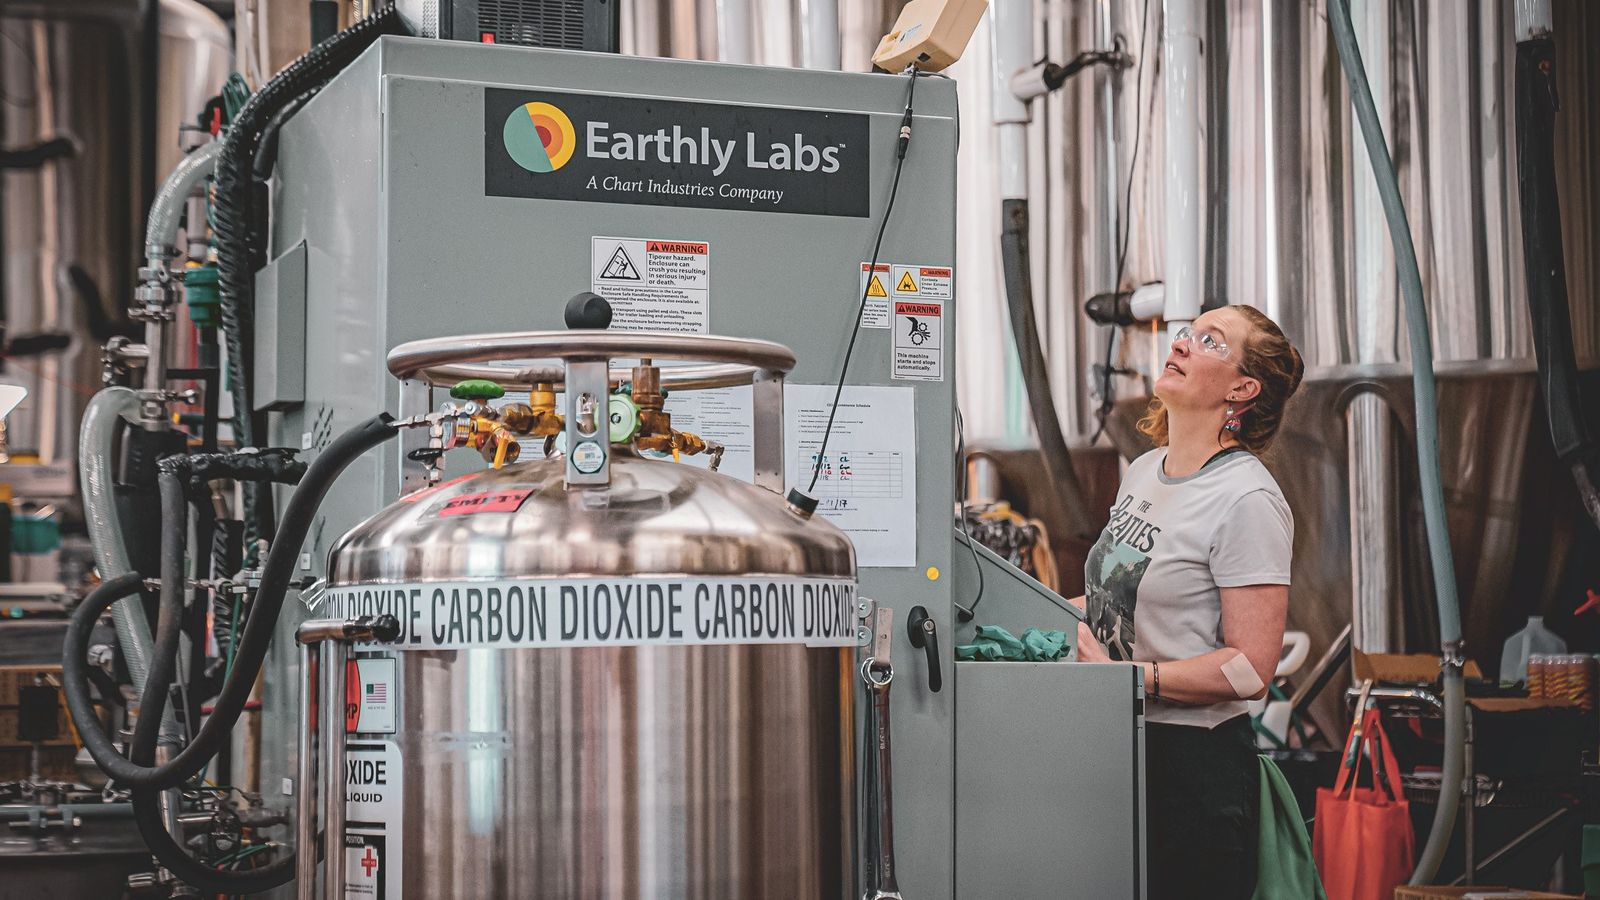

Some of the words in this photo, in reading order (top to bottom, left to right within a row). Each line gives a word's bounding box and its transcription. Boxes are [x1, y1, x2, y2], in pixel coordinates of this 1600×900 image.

[586, 120, 736, 176] Earthly
[746, 131, 841, 173] Labs
[586, 176, 598, 189] A
[602, 177, 643, 192] Chart
[647, 179, 715, 196] Industries
[718, 183, 784, 203] Company
[661, 244, 704, 254] WARNING
[905, 305, 939, 314] WARNING
[1138, 500, 1152, 513] THE
[431, 586, 547, 646] CARBON
[560, 584, 682, 640] DIOXIDE
[694, 583, 795, 640] CARBON
[803, 583, 854, 638] DIOXIDE
[346, 760, 386, 785] XIDE
